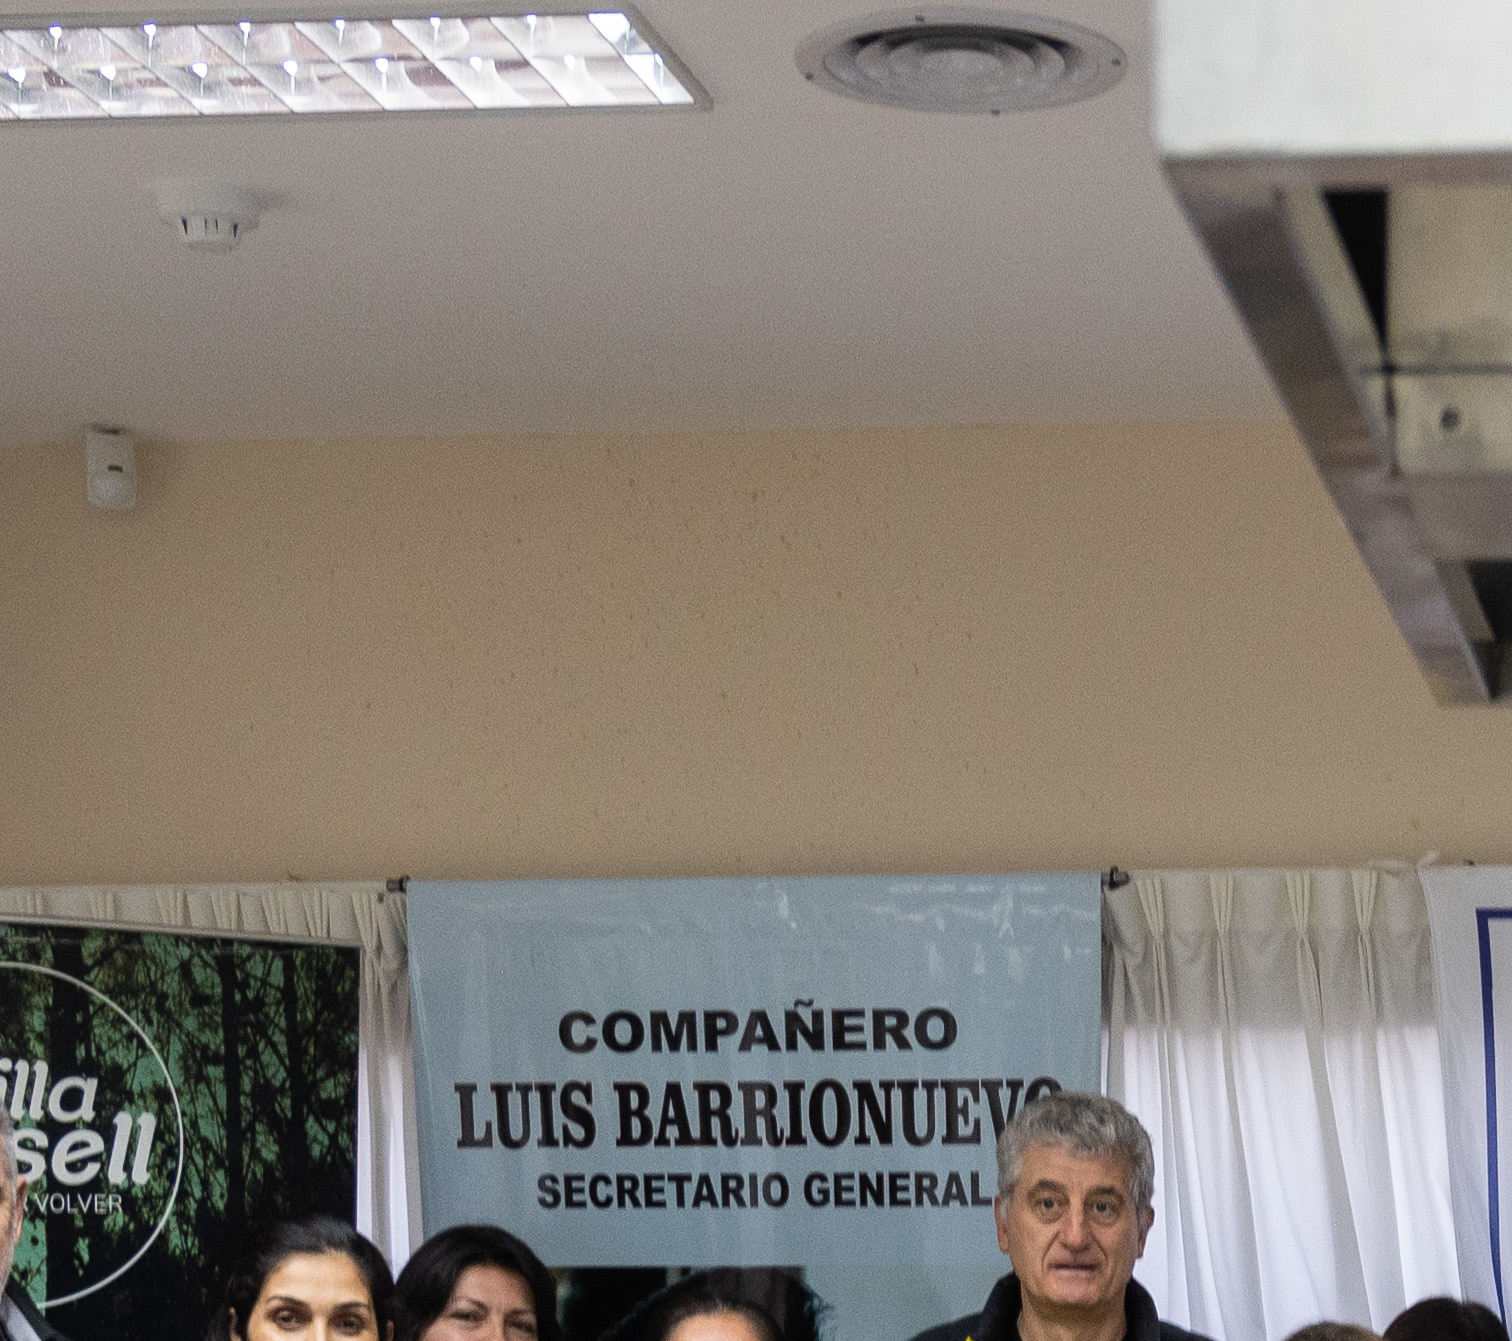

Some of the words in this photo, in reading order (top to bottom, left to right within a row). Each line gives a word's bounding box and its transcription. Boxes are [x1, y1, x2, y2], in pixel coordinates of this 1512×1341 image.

[558, 998, 959, 1055] COMPAÑERO
[454, 1081, 598, 1150] LUIS
[13, 1110, 157, 1186] sell
[35, 1192, 123, 1214] VOLVER
[536, 1171, 789, 1209] SECRETARIO
[803, 1170, 993, 1208] GENERAL
